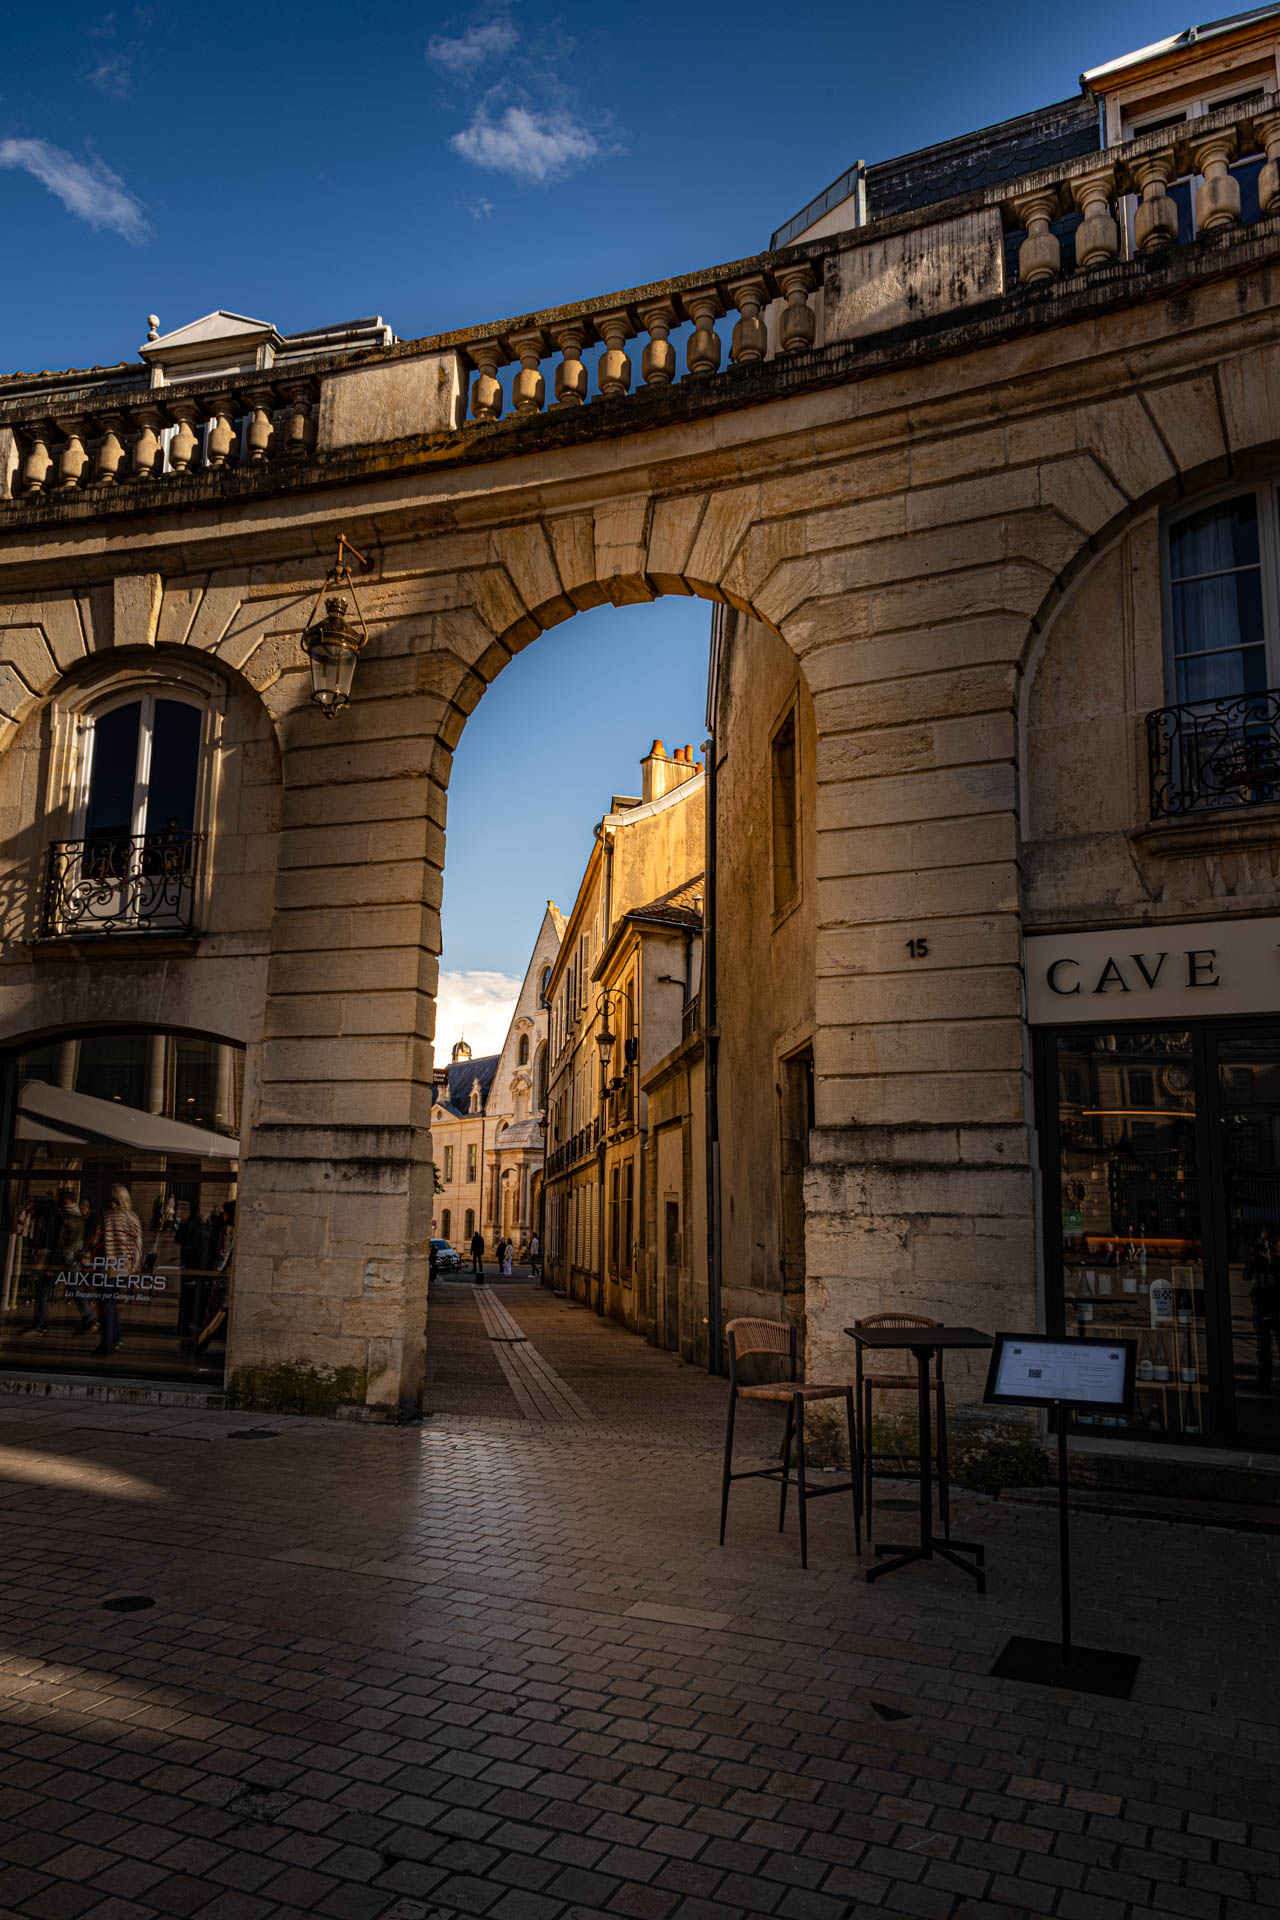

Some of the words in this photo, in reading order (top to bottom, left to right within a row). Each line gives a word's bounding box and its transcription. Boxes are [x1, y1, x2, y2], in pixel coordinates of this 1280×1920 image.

[905, 938, 928, 958] 15
[1046, 949, 1220, 995] CAVE
[93, 1252, 129, 1272] PRÉ
[54, 1271, 90, 1287] AUX
[92, 1272, 167, 1290] CLERCS
